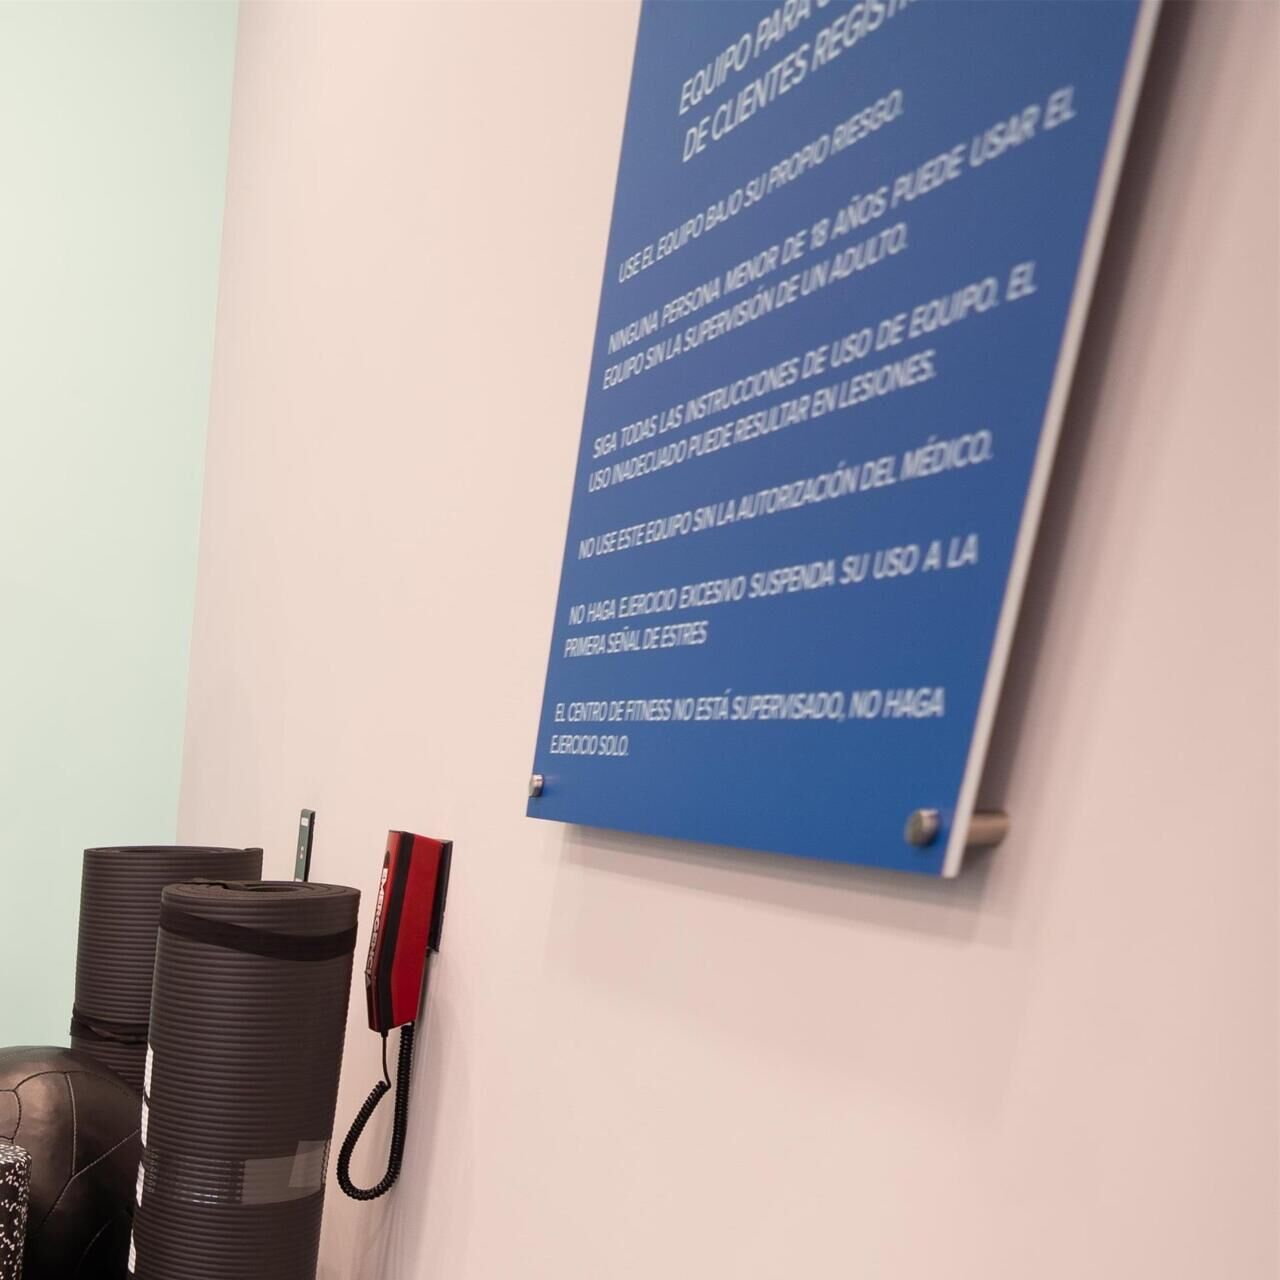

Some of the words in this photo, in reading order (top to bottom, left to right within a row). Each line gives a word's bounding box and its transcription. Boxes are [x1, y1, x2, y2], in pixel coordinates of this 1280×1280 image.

[679, 33, 751, 115] EQUIPO
[683, 116, 710, 162] DE
[711, 43, 810, 141] CLIENTES
[608, 310, 658, 354] NINGUNA
[661, 277, 720, 327] PERSONA
[723, 245, 780, 295] MENOR
[781, 230, 808, 265] DE
[810, 218, 830, 250] 18
[831, 186, 889, 240] AÑOS
[892, 144, 966, 209] PUEDE
[970, 105, 1040, 167] USAR
[1043, 85, 1077, 130] EL
[618, 252, 641, 283] USE
[641, 244, 655, 270] EL
[656, 213, 704, 261] EQUIPO
[705, 189, 742, 231] BAJO
[743, 172, 767, 208] SU
[767, 134, 830, 194] PROPIO
[830, 89, 903, 155] RIESGO.
[593, 433, 617, 459] SIGA
[620, 415, 658, 448] TODAS
[659, 404, 684, 434] LAS
[684, 357, 800, 424] INSTRUCCIONES
[802, 345, 829, 379] DE
[831, 328, 872, 368] USO
[875, 313, 907, 351] DE
[1006, 260, 1038, 301] EL
[602, 352, 644, 390] EQUIPO
[644, 344, 666, 370] SIN
[666, 333, 682, 361] LA
[683, 285, 775, 352] SUPERVISIÓN
[775, 274, 800, 308] DE
[800, 261, 830, 296] UN
[829, 222, 908, 284] ADULTO.
[588, 466, 611, 493] USO
[611, 439, 687, 485] INADECUADO
[688, 422, 734, 460] PUEDE
[733, 395, 810, 444] RESULTAR
[811, 383, 839, 418] EN
[839, 349, 937, 409] LESIONES.
[578, 537, 596, 561] NO
[596, 531, 617, 556] USE
[617, 523, 646, 551] ESTE
[645, 511, 691, 550] EQUIPO
[691, 505, 715, 533] SIN
[716, 499, 736, 526] LA
[736, 461, 861, 521] AUTORIZACIÓN
[860, 455, 897, 492] DEL
[900, 428, 993, 481] MÉDICO.
[563, 638, 607, 658] PRIMERA
[607, 625, 641, 654] SEÑAL
[642, 626, 662, 650] DE
[660, 620, 709, 649] ESTRES
[568, 604, 585, 626] NO
[586, 599, 616, 623] HAGA
[618, 588, 677, 618] EJERCICIO
[678, 575, 746, 609] EXCESIVO
[748, 559, 835, 599] SUSPENDA
[839, 552, 871, 585] SU
[872, 544, 920, 580] USO
[922, 540, 941, 573] A
[946, 532, 979, 568] LA
[550, 735, 598, 754] EJERCICIO
[555, 703, 566, 722] EL
[568, 701, 608, 722] CENTRO
[608, 700, 625, 722] DE
[624, 699, 673, 721] FITNESS
[672, 698, 695, 721] NO
[695, 688, 732, 721] ESTÁ
[848, 689, 881, 719] NO
[882, 687, 946, 719] HAGA
